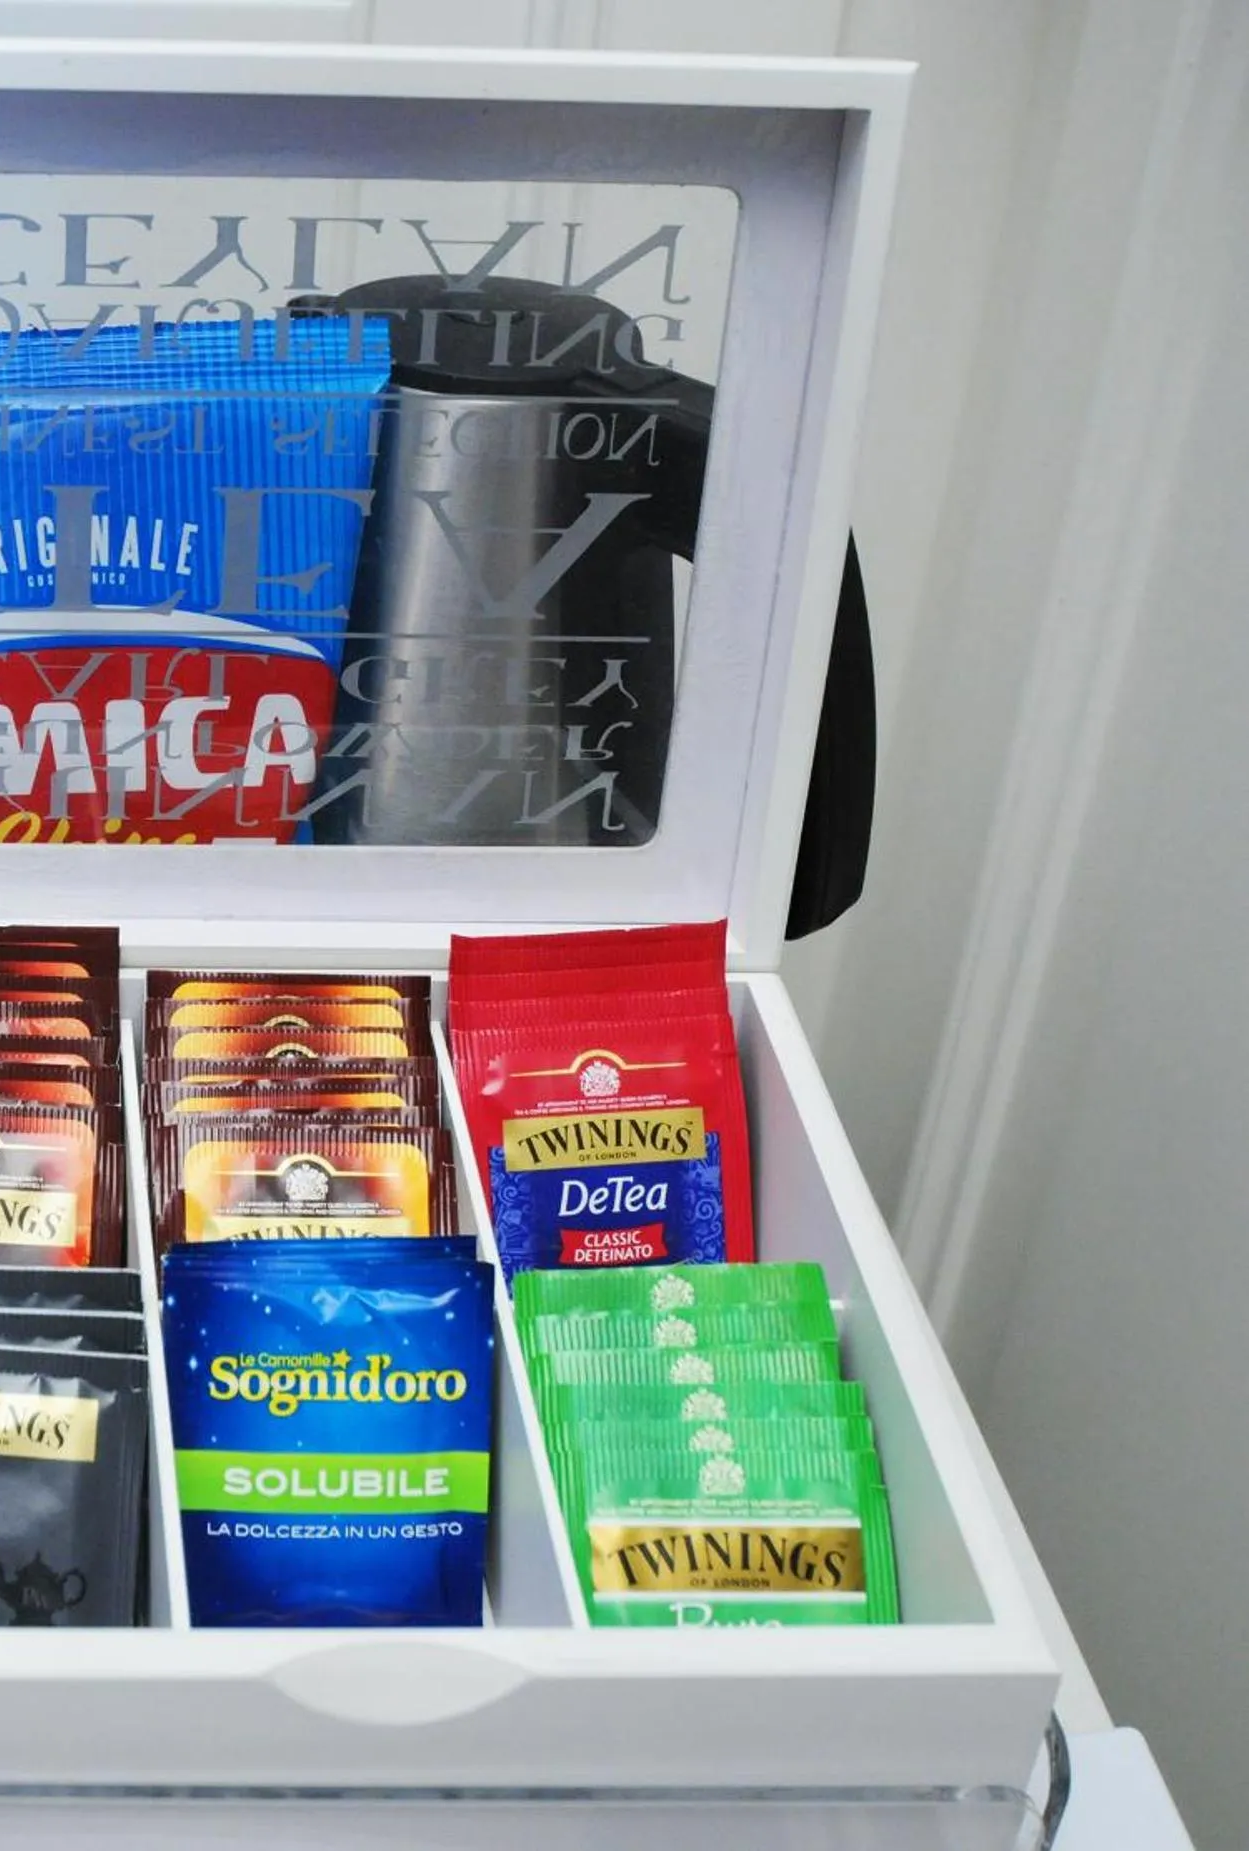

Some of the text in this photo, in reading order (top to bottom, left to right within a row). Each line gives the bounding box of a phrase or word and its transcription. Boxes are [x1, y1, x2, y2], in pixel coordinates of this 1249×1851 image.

[518, 1118, 692, 1166] TWININGS
[579, 1152, 637, 1162] OF LONDON
[558, 1175, 669, 1217] DeTea
[583, 1230, 642, 1248] CLASSIC
[574, 1244, 654, 1263] DETEINATO
[224, 1467, 449, 1497] SOLUBILE
[207, 1522, 463, 1539] LA DOLCEZZA IN UN GESTO
[607, 1531, 847, 1587] TWININGS
[713, 1578, 771, 1588] LONDON
